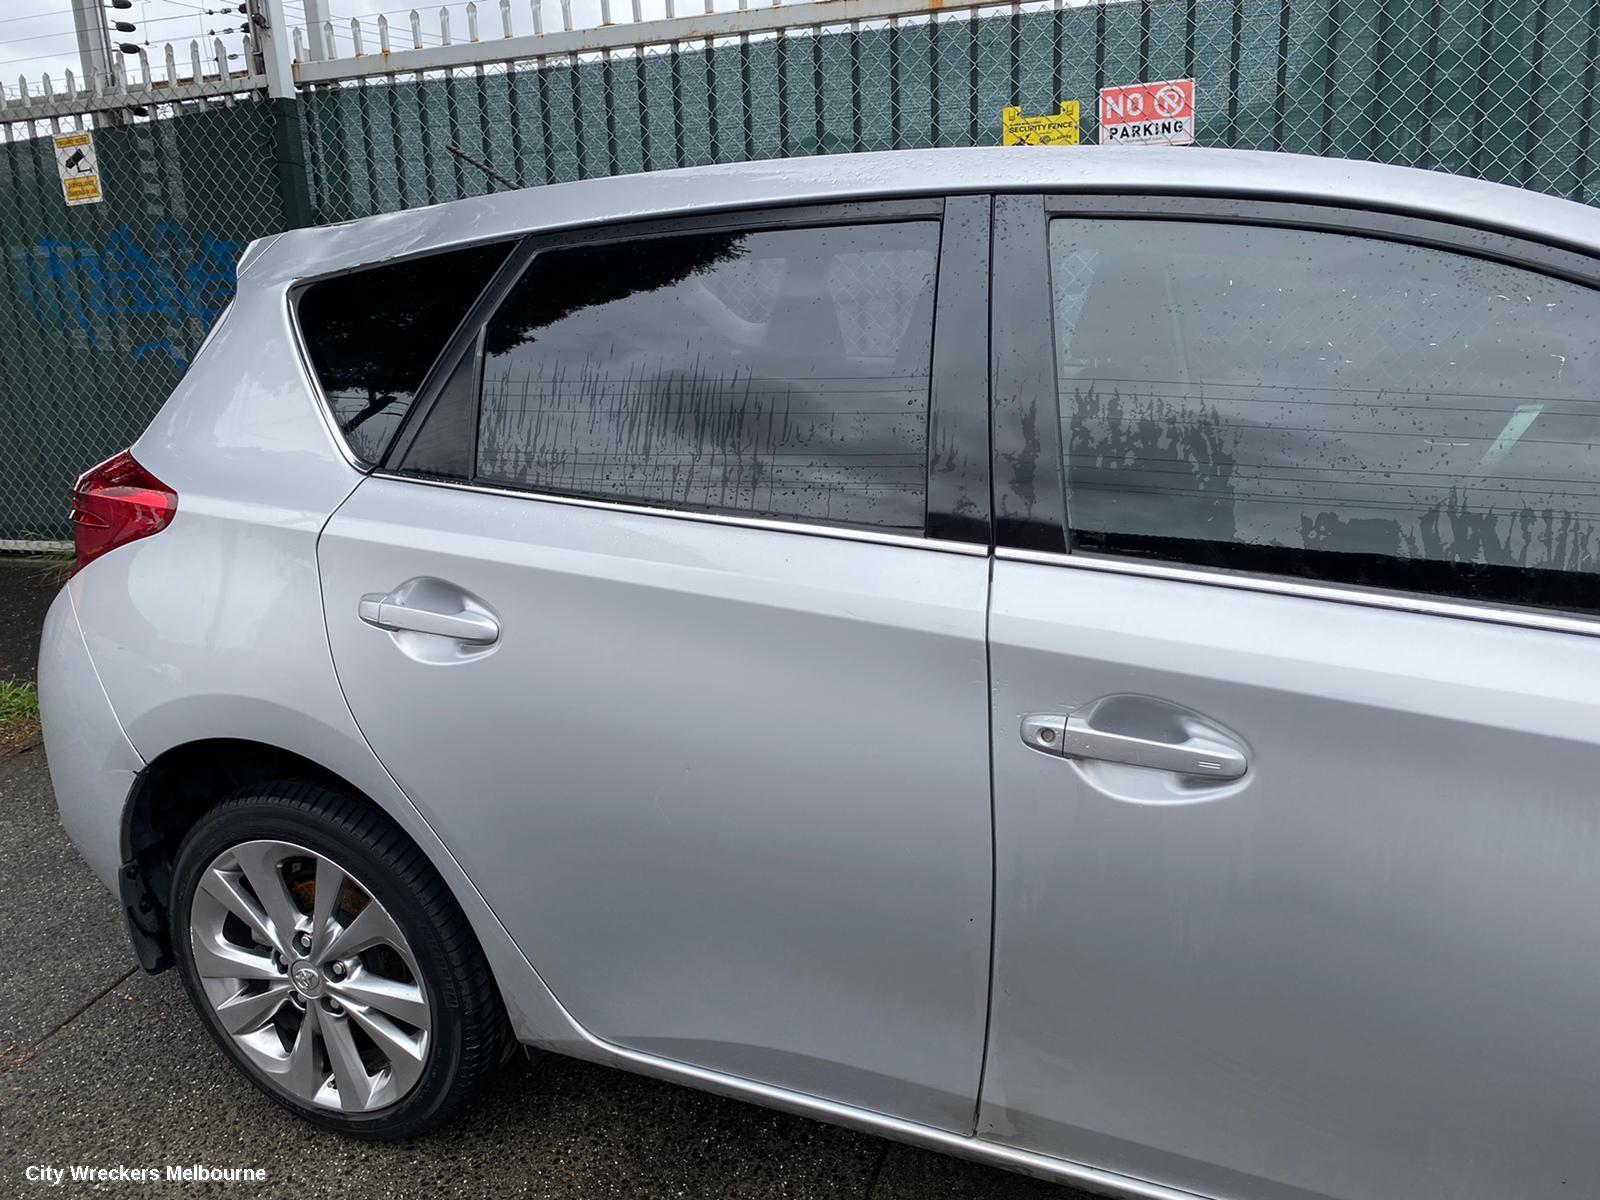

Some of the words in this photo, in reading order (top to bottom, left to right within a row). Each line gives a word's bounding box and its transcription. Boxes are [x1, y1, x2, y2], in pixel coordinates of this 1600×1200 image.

[1106, 93, 1144, 119] NO
[1008, 123, 1047, 134] SECURITY
[1048, 121, 1073, 130] FENCE
[1109, 120, 1184, 140] PARKING
